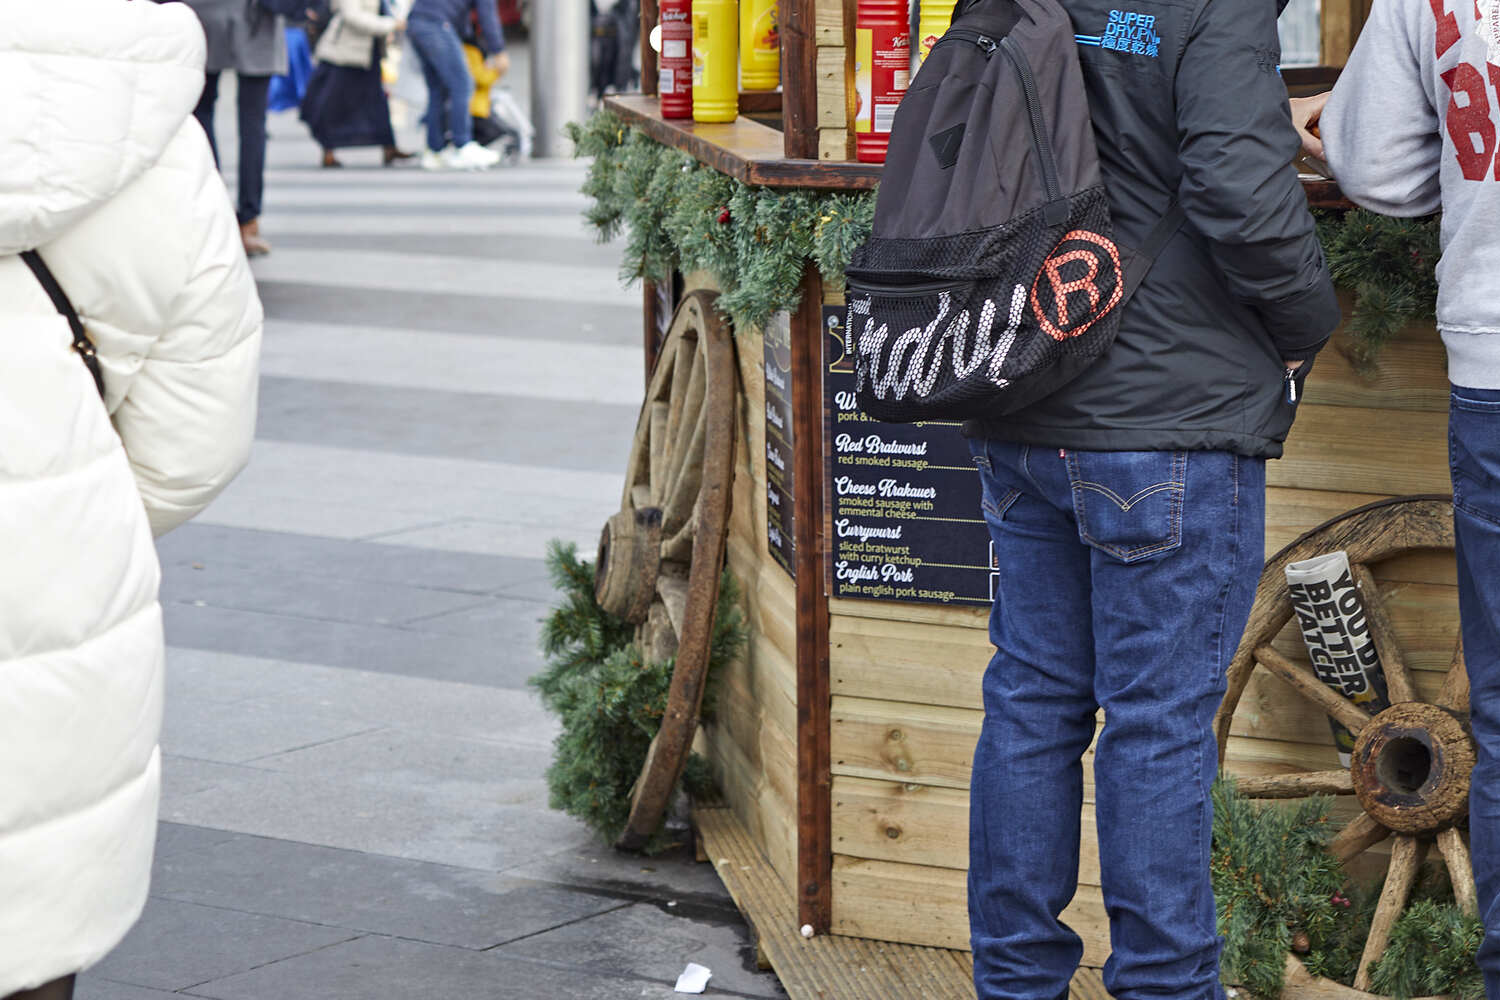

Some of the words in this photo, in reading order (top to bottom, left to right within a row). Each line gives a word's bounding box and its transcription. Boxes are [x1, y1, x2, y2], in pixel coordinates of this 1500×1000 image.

[1108, 9, 1156, 29] SUPER
[838, 412, 858, 423] pork
[835, 433, 864, 452] Red
[865, 434, 927, 455] Bratwurst
[838, 454, 853, 464] red
[855, 456, 890, 466] smoked
[834, 476, 876, 495] Cheese
[878, 478, 936, 499] Krakauer
[839, 497, 874, 507] smoked
[875, 499, 912, 511] sausage
[913, 500, 934, 510] with
[839, 507, 883, 517] emmental
[835, 518, 902, 542] Currywurst
[839, 541, 864, 552] sliced
[866, 542, 910, 555] bratwurst
[839, 552, 859, 562] with
[861, 554, 883, 565] curry
[835, 560, 880, 584] English
[880, 563, 914, 582] Pork
[839, 583, 861, 594] plain
[862, 585, 894, 597] english
[896, 587, 916, 598] pork
[1288, 583, 1342, 687] WATCH
[1304, 579, 1368, 695] BETTER
